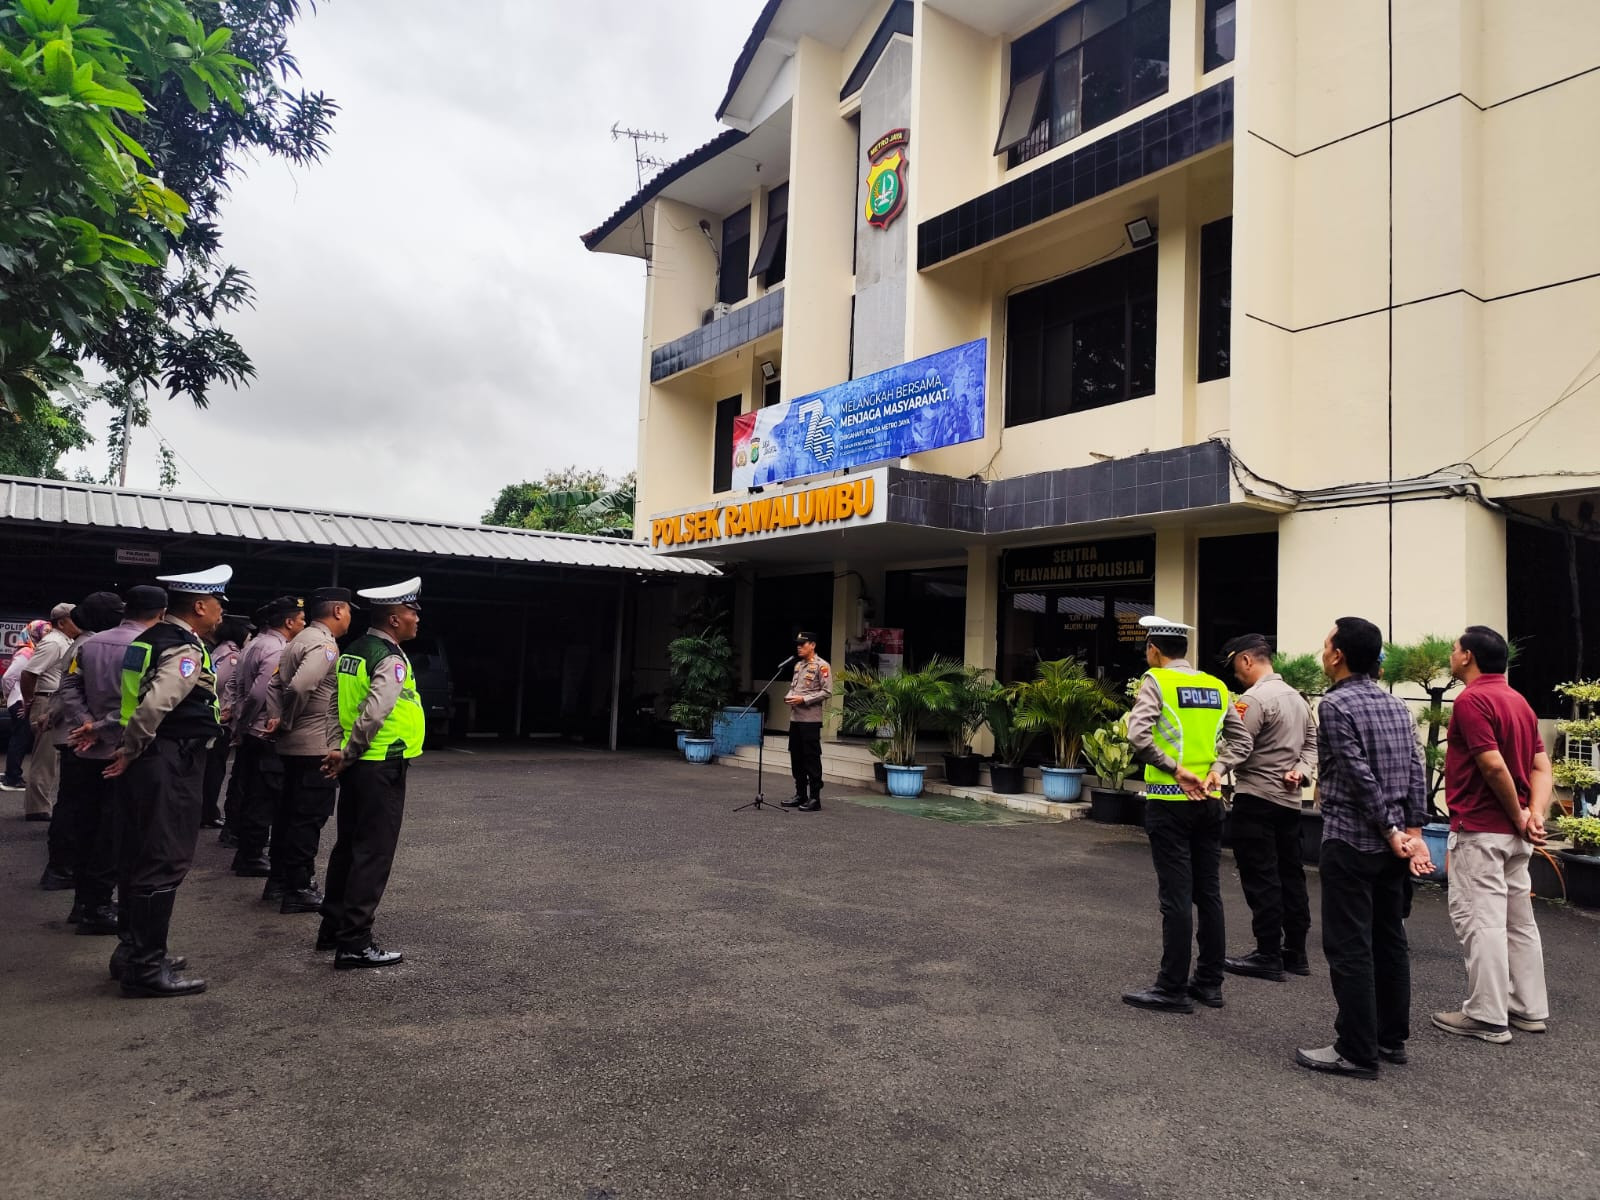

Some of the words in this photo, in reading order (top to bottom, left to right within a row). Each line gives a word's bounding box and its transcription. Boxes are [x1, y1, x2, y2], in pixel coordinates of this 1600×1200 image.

[870, 138, 889, 156] METRO
[889, 132, 902, 142] JAYA
[841, 389, 894, 413] MELANGKAH
[896, 375, 944, 399] BERSAMA,
[841, 408, 881, 427] MENJAGA
[883, 388, 950, 416] MASYARAKAT.
[866, 426, 881, 436] POLDA
[882, 422, 898, 431] METRO
[652, 508, 721, 547] POLSEK
[725, 478, 875, 536] RAWALUMBU
[1053, 546, 1098, 563] SENTRA
[1014, 565, 1072, 582] PELAYANAN
[1076, 560, 1144, 579] KEPOLISIAN
[1181, 689, 1220, 705] POLISI
